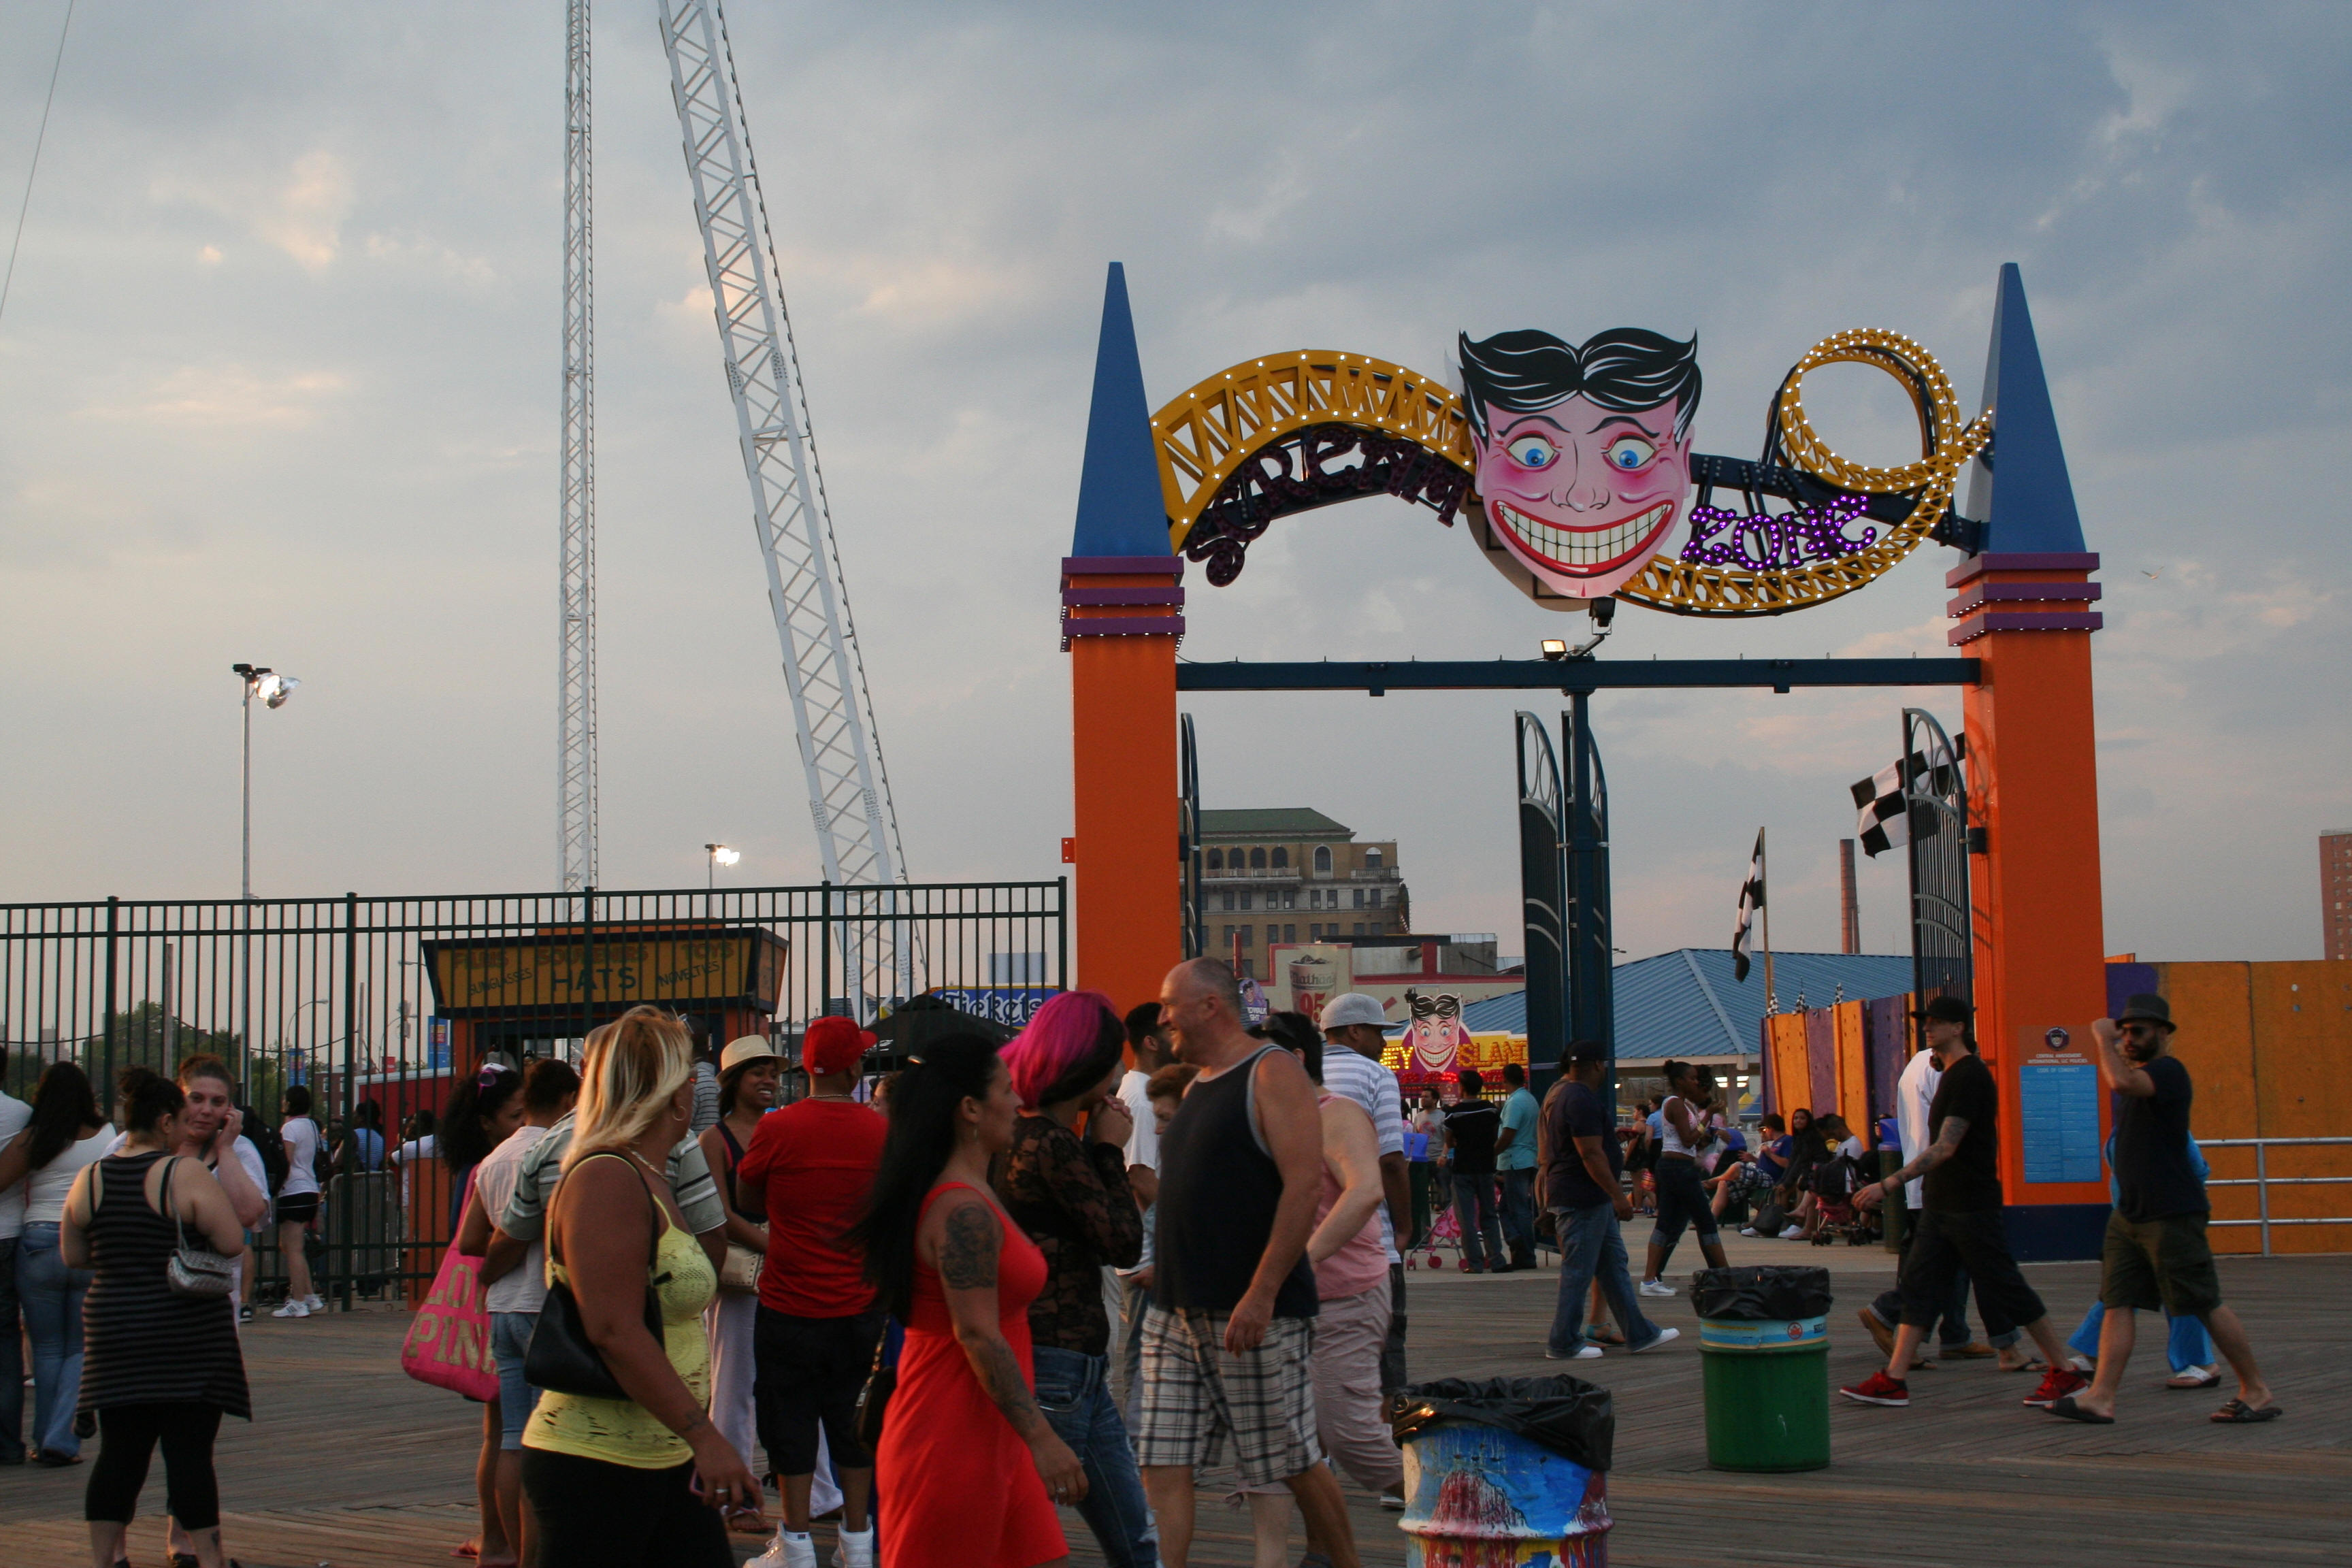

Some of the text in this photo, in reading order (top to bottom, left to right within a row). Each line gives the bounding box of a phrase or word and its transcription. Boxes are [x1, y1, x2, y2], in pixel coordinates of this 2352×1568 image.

[1186, 429, 1877, 587] SCREAM ZONE
[552, 966, 636, 992] HATS
[941, 991, 1044, 1026] Tickets
